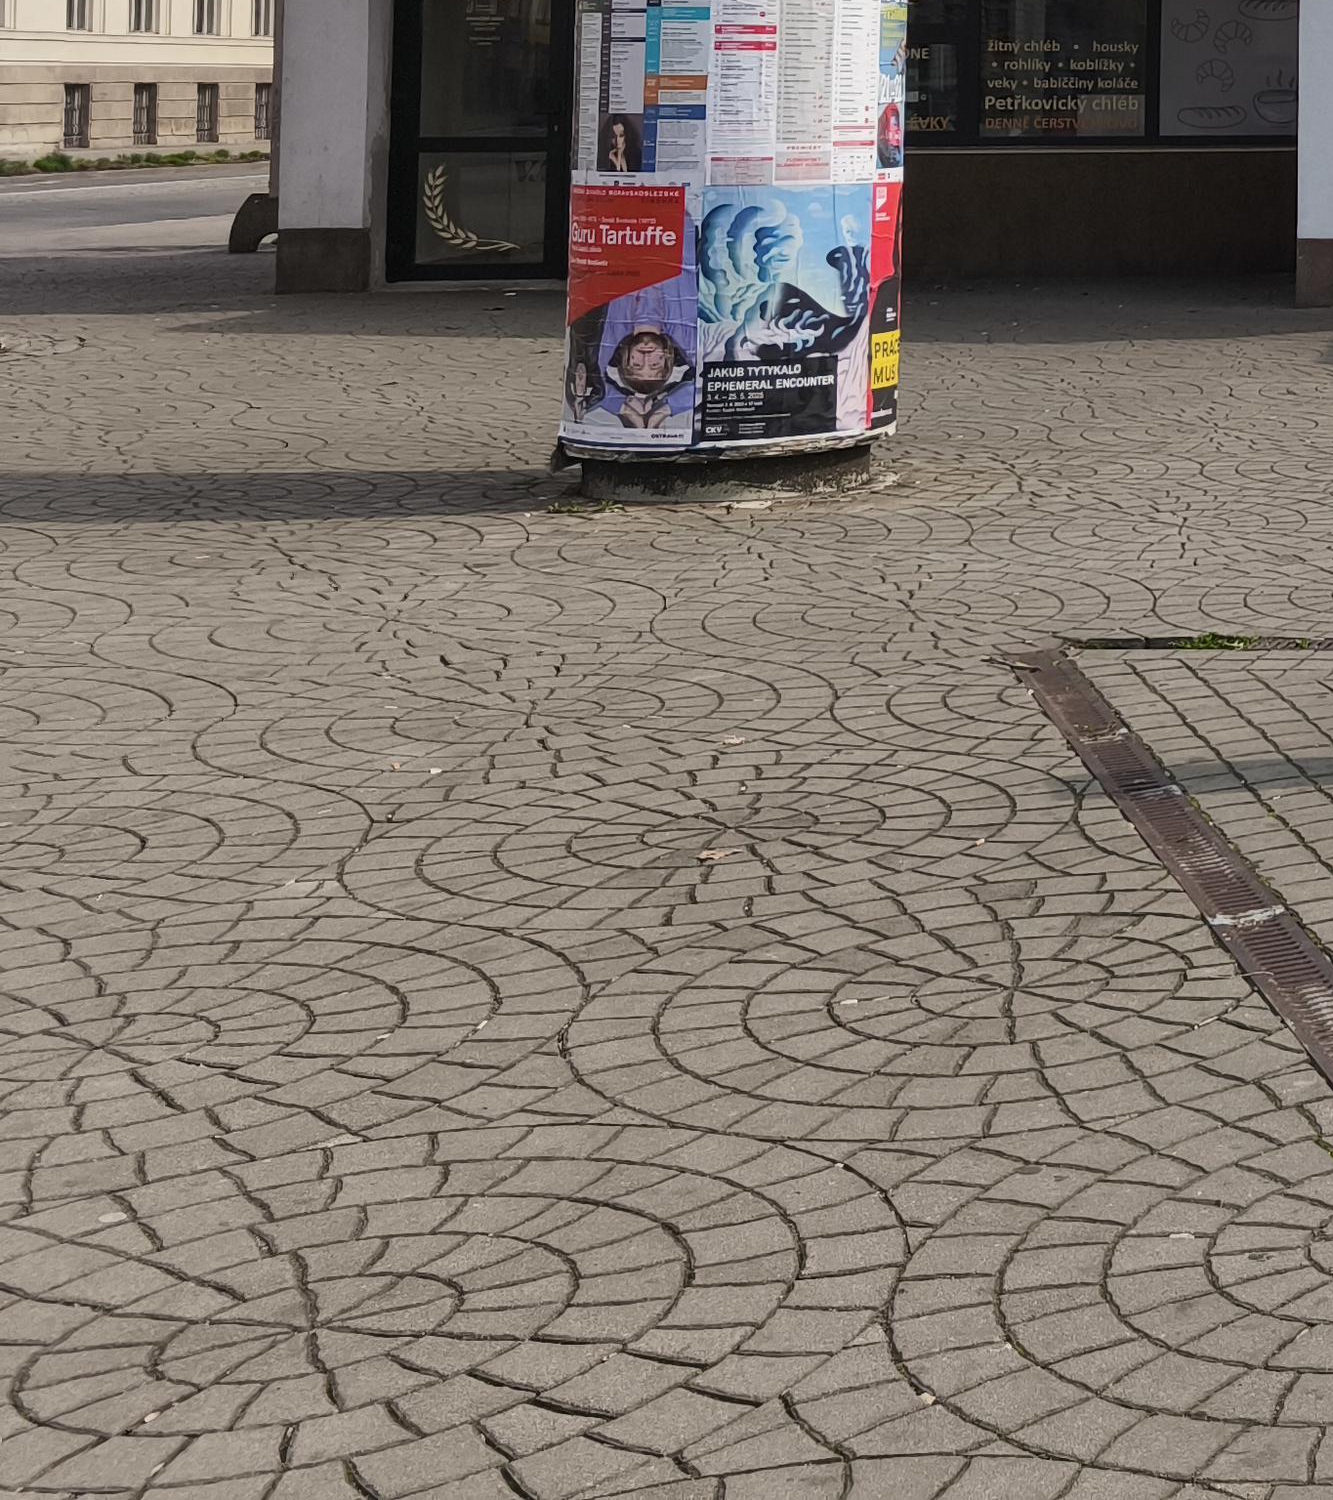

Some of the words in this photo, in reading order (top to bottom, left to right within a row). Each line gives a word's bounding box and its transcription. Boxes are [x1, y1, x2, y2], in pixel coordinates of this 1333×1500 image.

[987, 39, 1021, 55] žitný
[1024, 40, 1061, 52] chléb
[1092, 41, 1139, 55] housky
[1004, 58, 1051, 73] rohlíky
[1070, 58, 1124, 73] koblížky
[987, 77, 1018, 90] veky
[1033, 76, 1094, 92] babiččiny
[1098, 77, 1139, 90] koláče
[984, 95, 1087, 114] Petřkovický
[1092, 96, 1139, 111] chléb
[572, 222, 595, 244] Guru
[599, 224, 677, 246] Tartuffe
[707, 367, 744, 378] JAKUB
[707, 379, 773, 392] EPHEMERAL
[776, 375, 835, 389] ENCOUNTER
